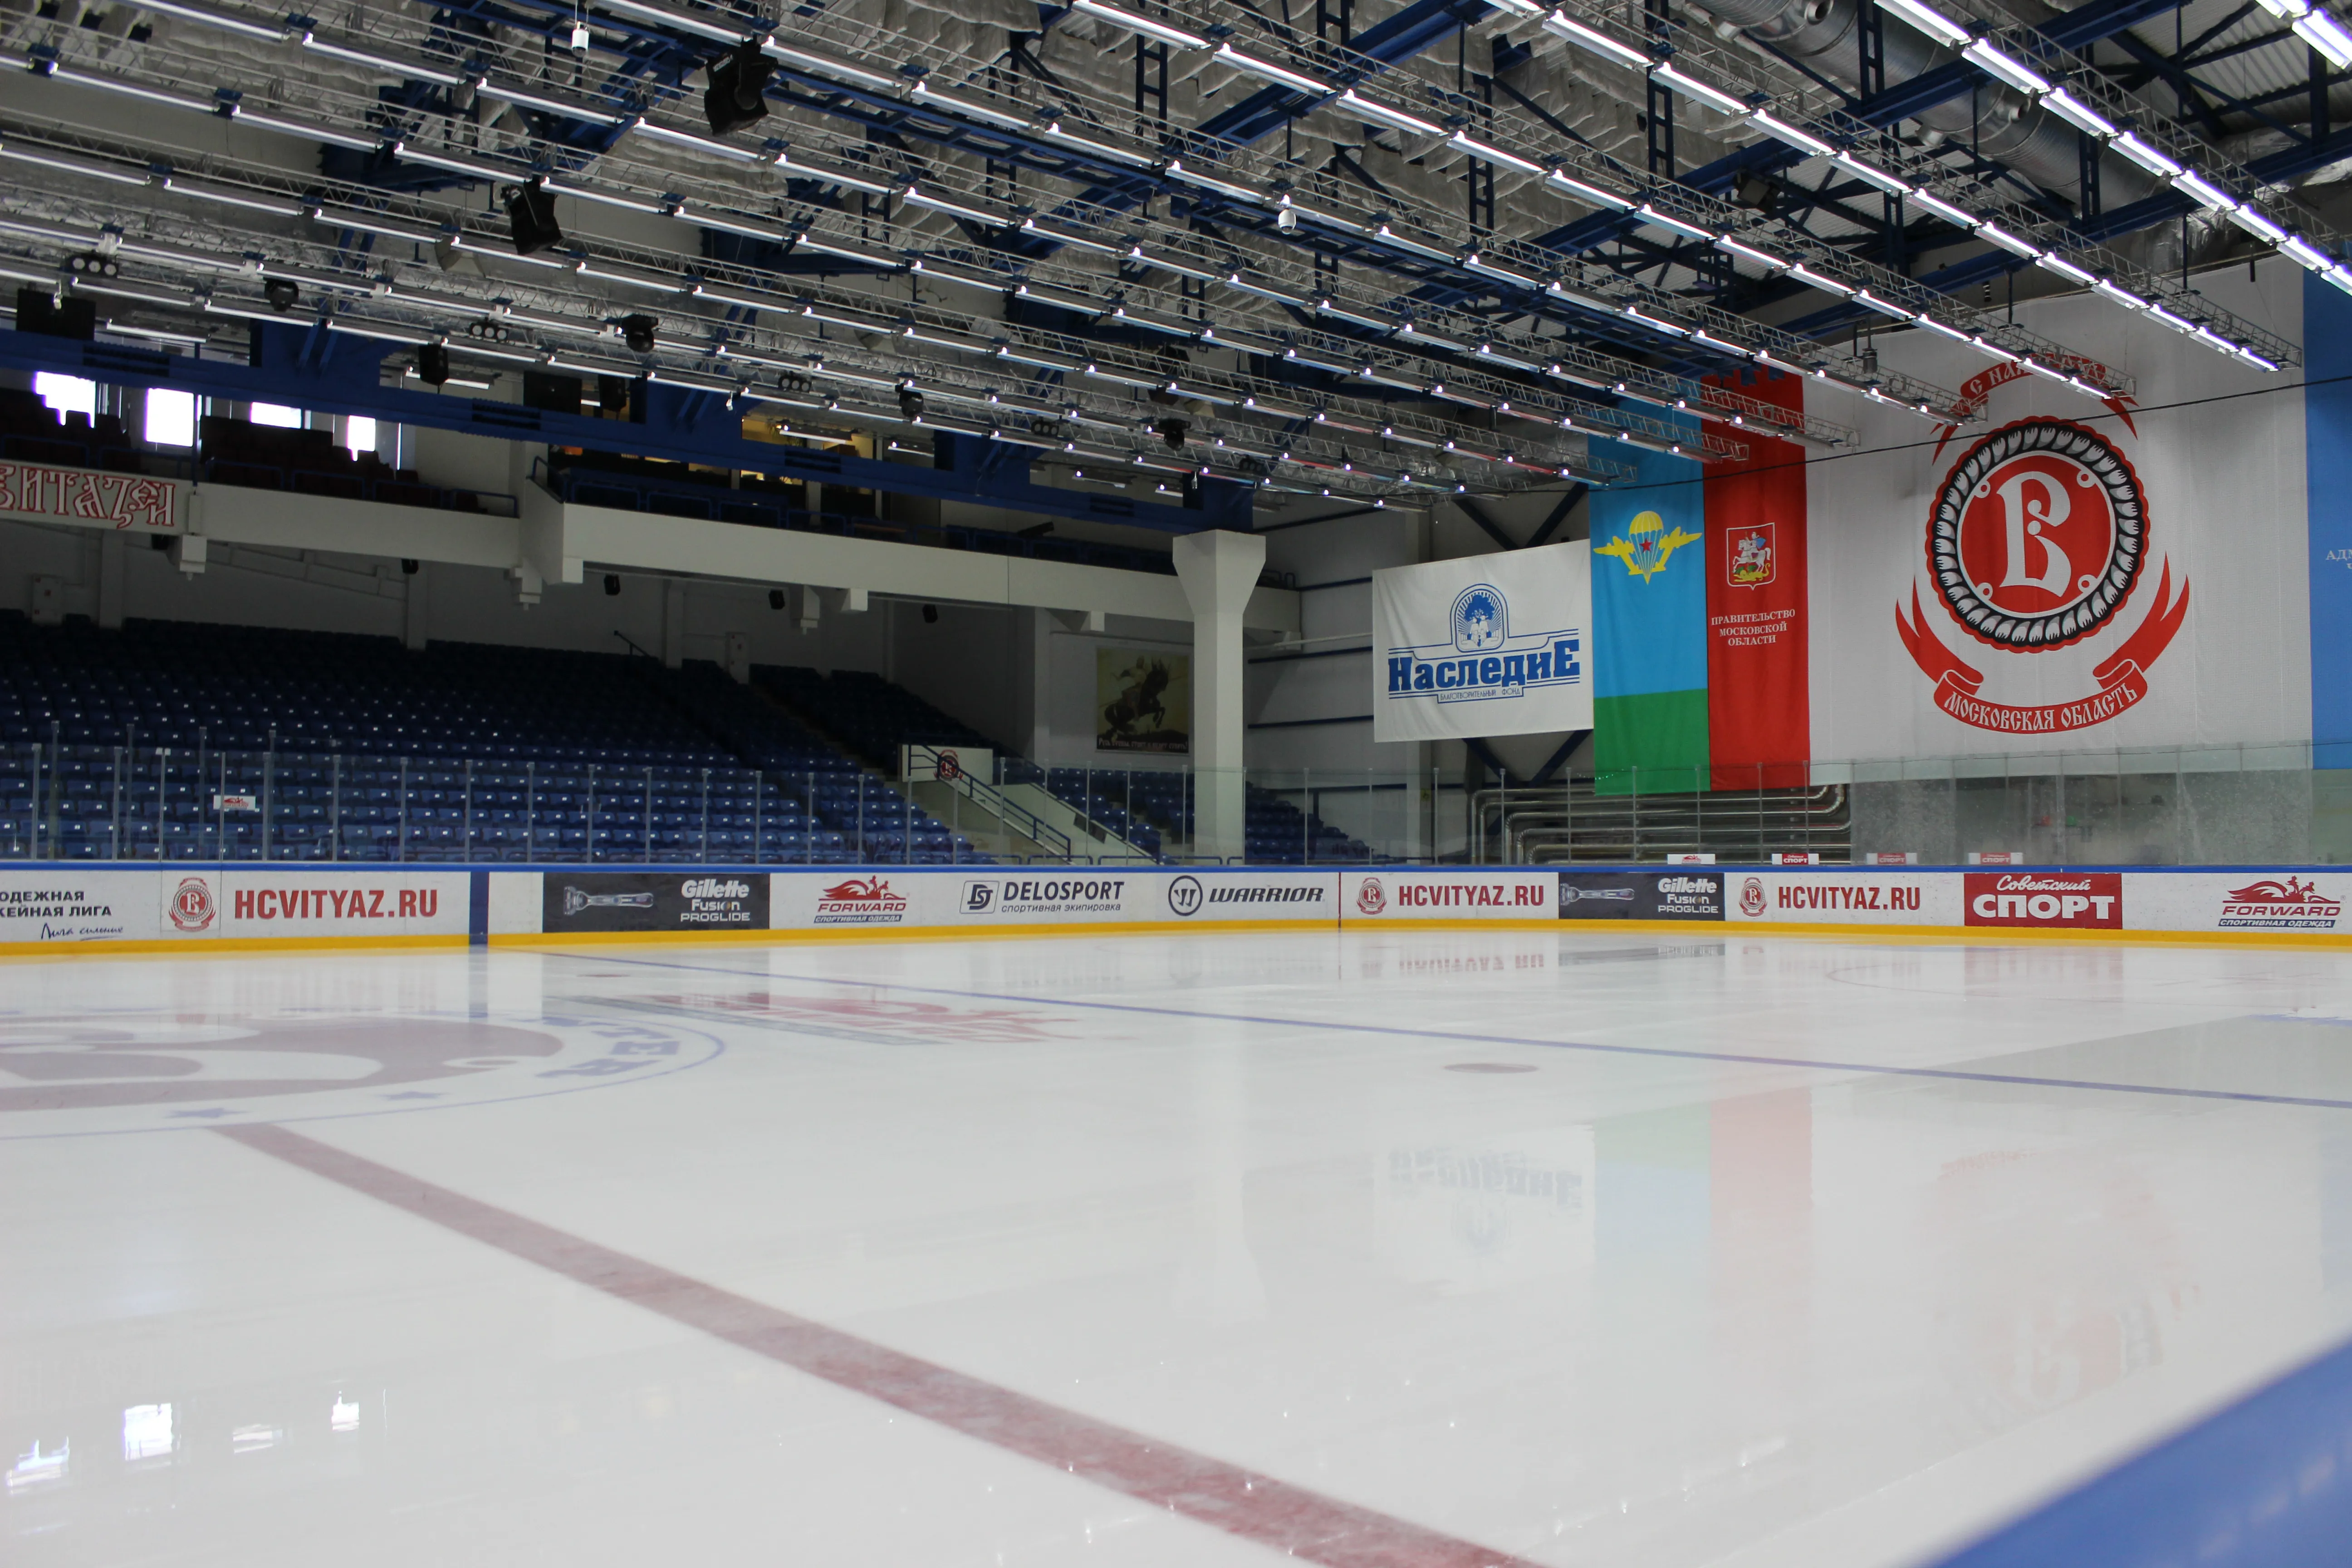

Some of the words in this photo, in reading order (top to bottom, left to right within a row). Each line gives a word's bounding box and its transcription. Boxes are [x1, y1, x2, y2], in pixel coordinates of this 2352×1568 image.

[1711, 609, 1795, 626] ПРАВИТЕЛЬСТВО
[1720, 621, 1787, 637] МОСКОВСКОЙ
[1728, 635, 1776, 646] ОБЛАСТИ
[1440, 689, 1496, 701] БЛАГОТВОРИТЕЛЬНЫЙ
[1502, 687, 1520, 696] ФОНД
[1944, 691, 2055, 731] МОСКОВСКАЯ
[2061, 683, 2138, 727] ОБЛАСТЬ
[681, 878, 750, 898] Gillette
[1658, 877, 1717, 893] Gillette
[1996, 875, 2091, 891] Советский
[1003, 882, 1125, 901] DELOSPORT
[1209, 887, 1324, 902] WARRIOR
[1399, 885, 1544, 906] HCVITYAZ.RU
[1779, 886, 1921, 910] HCVITYAZ.RU
[69, 906, 112, 916] ЛИГА
[235, 889, 437, 919] HCVITYAZ.RU
[818, 903, 906, 912] FORWARD
[1001, 904, 1061, 913] спортивная
[1064, 903, 1121, 913] экипировка
[1658, 905, 1719, 913] PROGLIDE
[1973, 894, 2115, 920] СПОРТ
[2222, 906, 2341, 916] FORWARD
[681, 912, 750, 922] PROGLIDE
[2288, 920, 2332, 928] ОДЕЖДА
